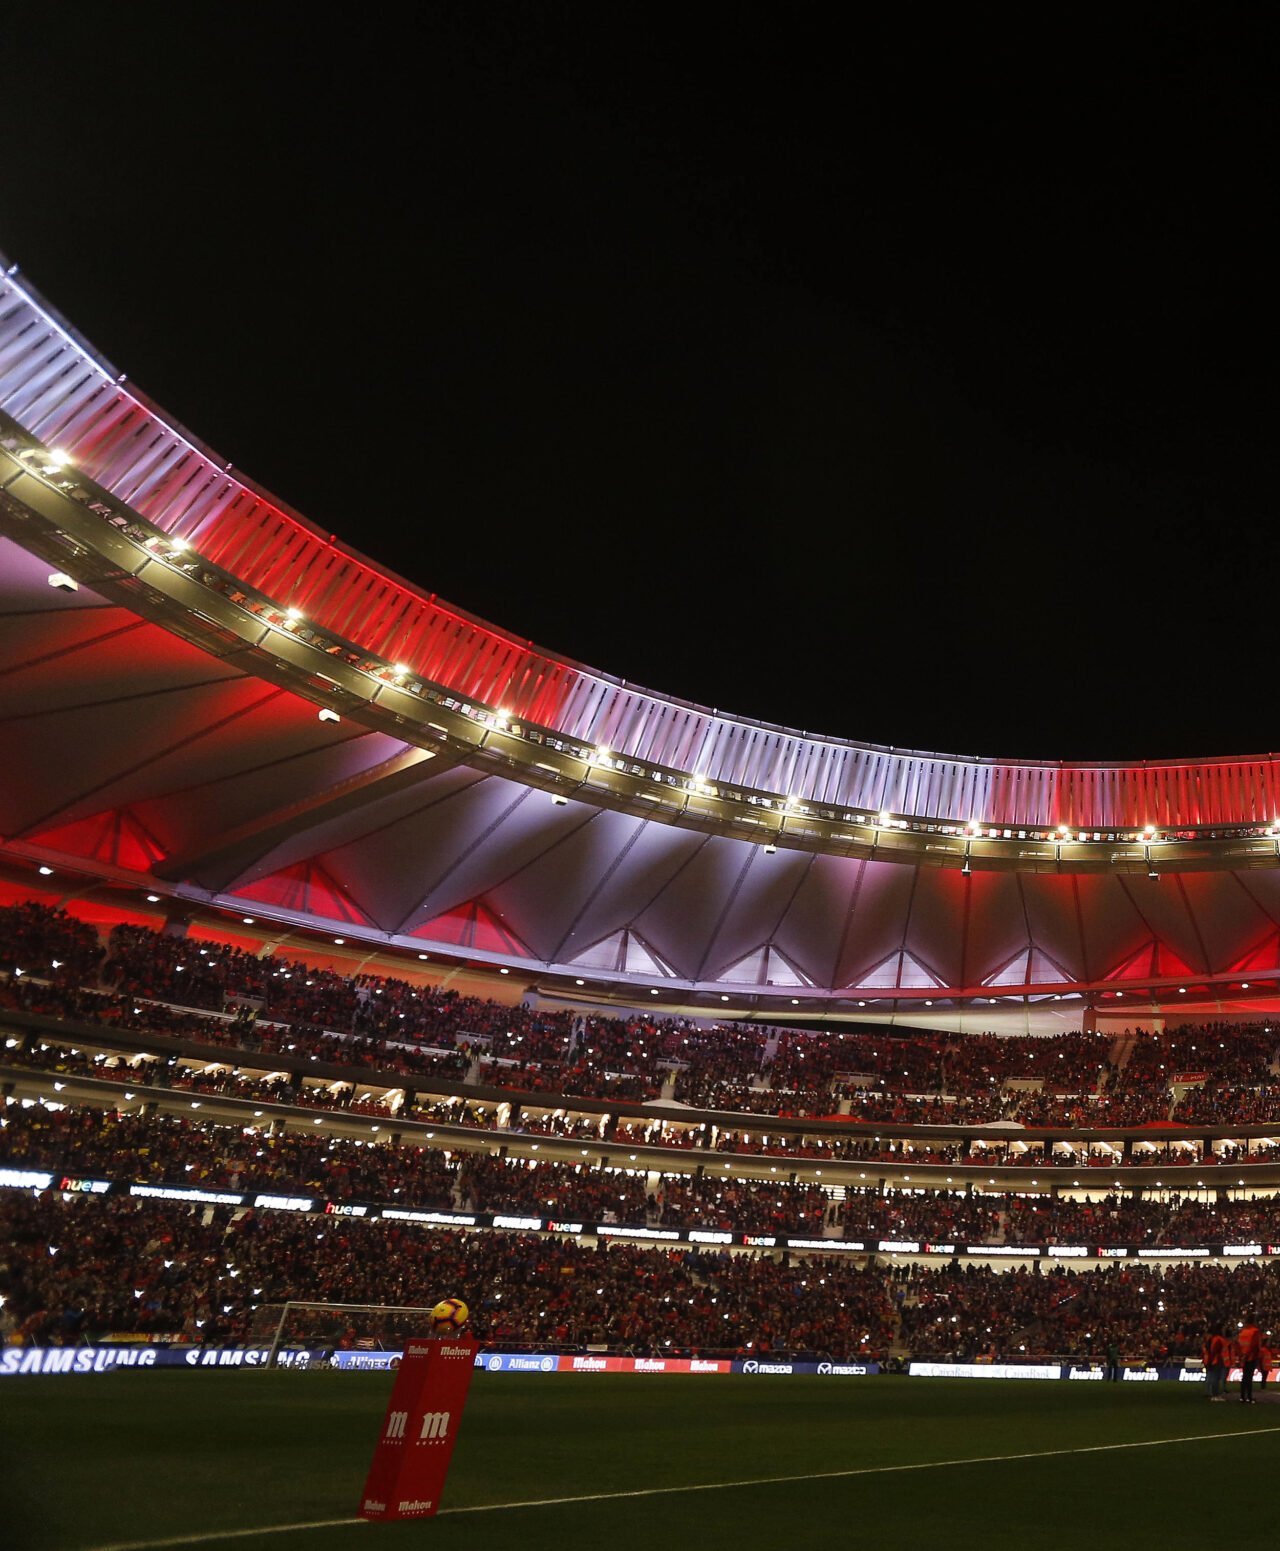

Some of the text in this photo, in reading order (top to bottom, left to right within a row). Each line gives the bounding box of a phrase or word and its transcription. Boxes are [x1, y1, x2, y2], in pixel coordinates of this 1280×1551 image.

[60, 1177, 91, 1192] hue
[254, 1194, 312, 1211] PHILIPS
[325, 1202, 352, 1215] hue
[548, 1220, 571, 1232] hue
[743, 1234, 764, 1246] hue
[925, 1243, 944, 1253] hue
[1098, 1247, 1117, 1257] hue
[440, 1346, 472, 1356] Mahou
[0, 1349, 156, 1374] SAMSUNG
[508, 1358, 540, 1369] Allianz
[573, 1357, 606, 1368] Mahou
[635, 1358, 665, 1370] Mahou
[759, 1364, 792, 1374] mazda
[931, 1365, 974, 1377] CaixaBank
[398, 1500, 432, 1512] Mahou
